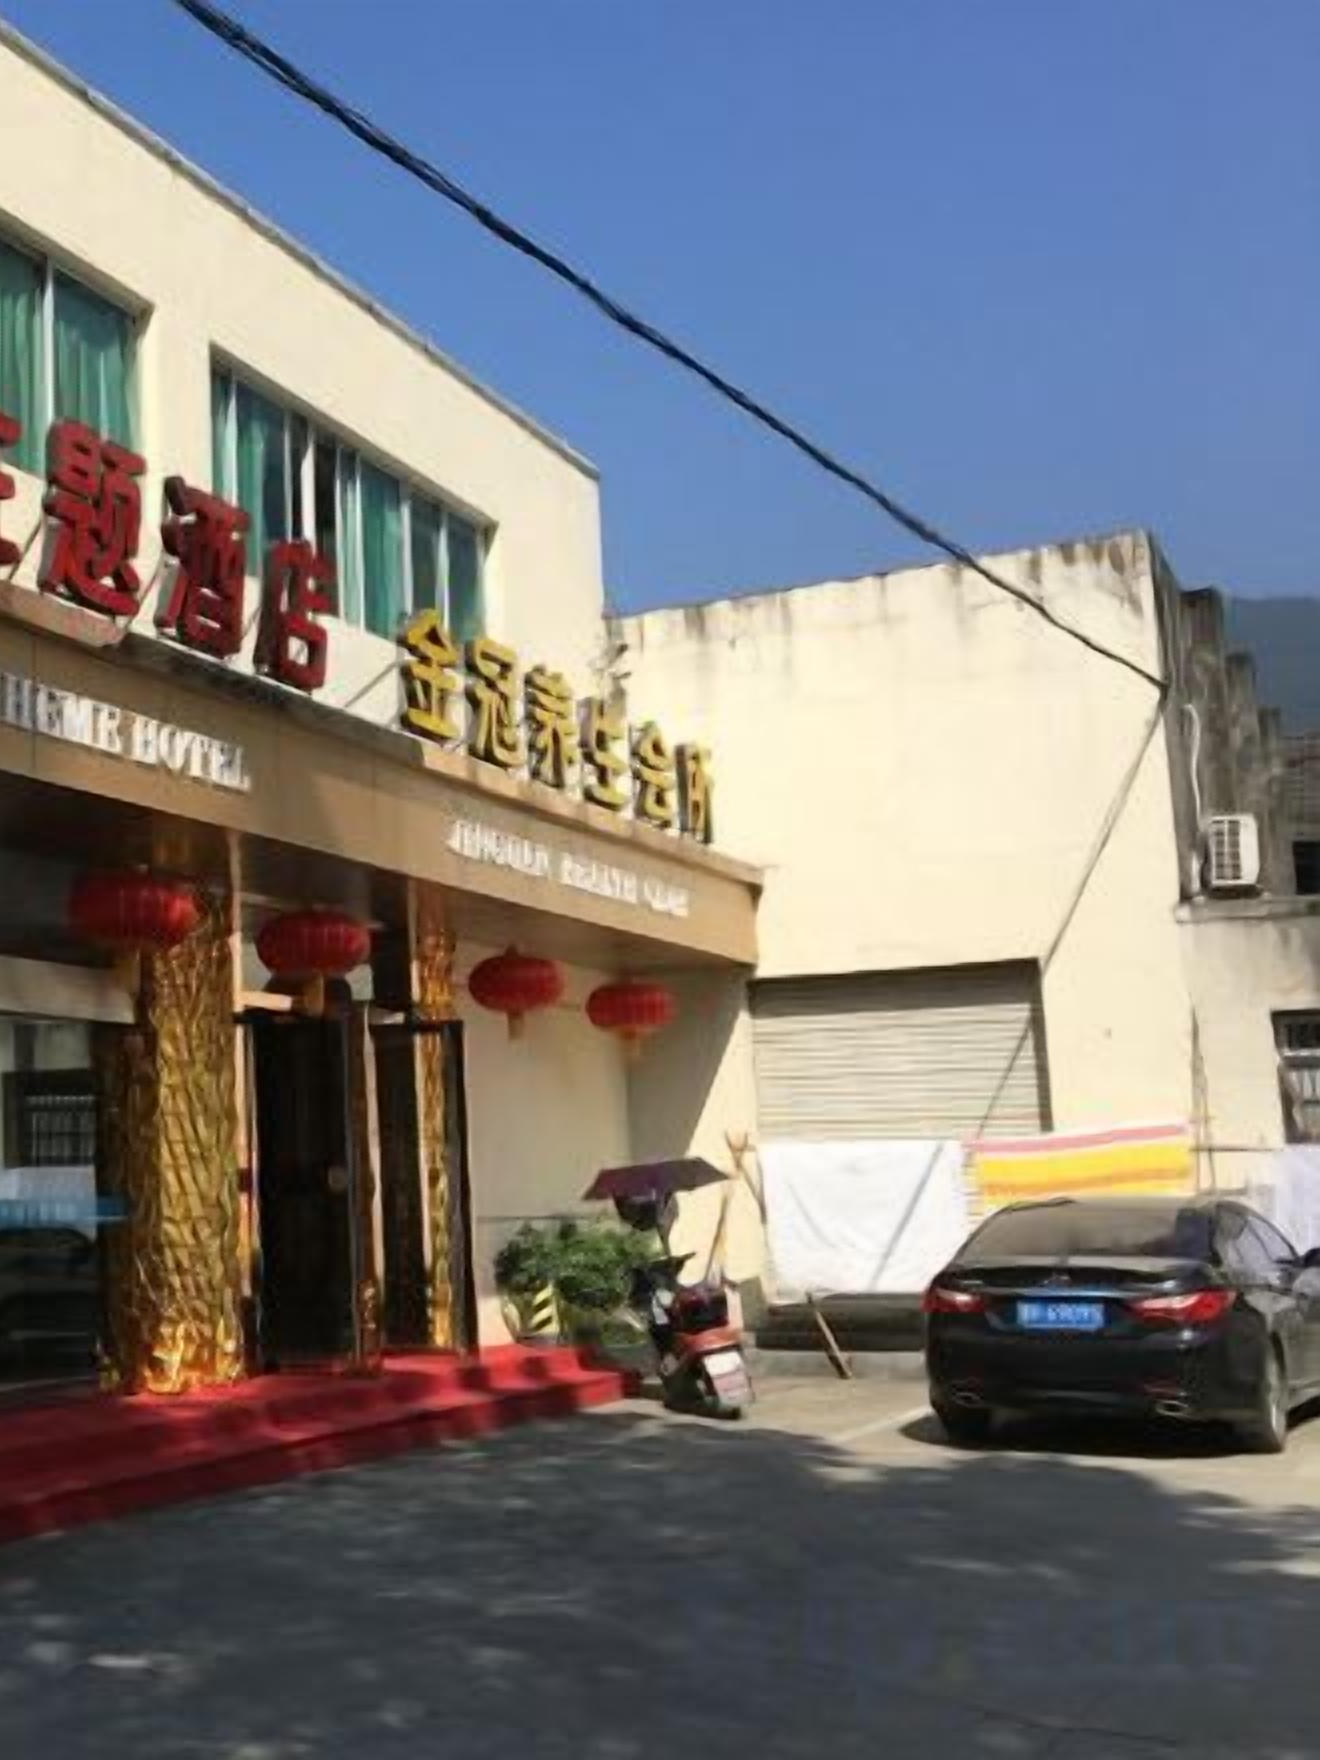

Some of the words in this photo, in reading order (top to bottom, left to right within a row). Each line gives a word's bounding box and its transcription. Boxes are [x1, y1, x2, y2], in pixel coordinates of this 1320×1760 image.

[131, 710, 252, 792] HOTEL
[397, 608, 714, 845] 金冠养生会所
